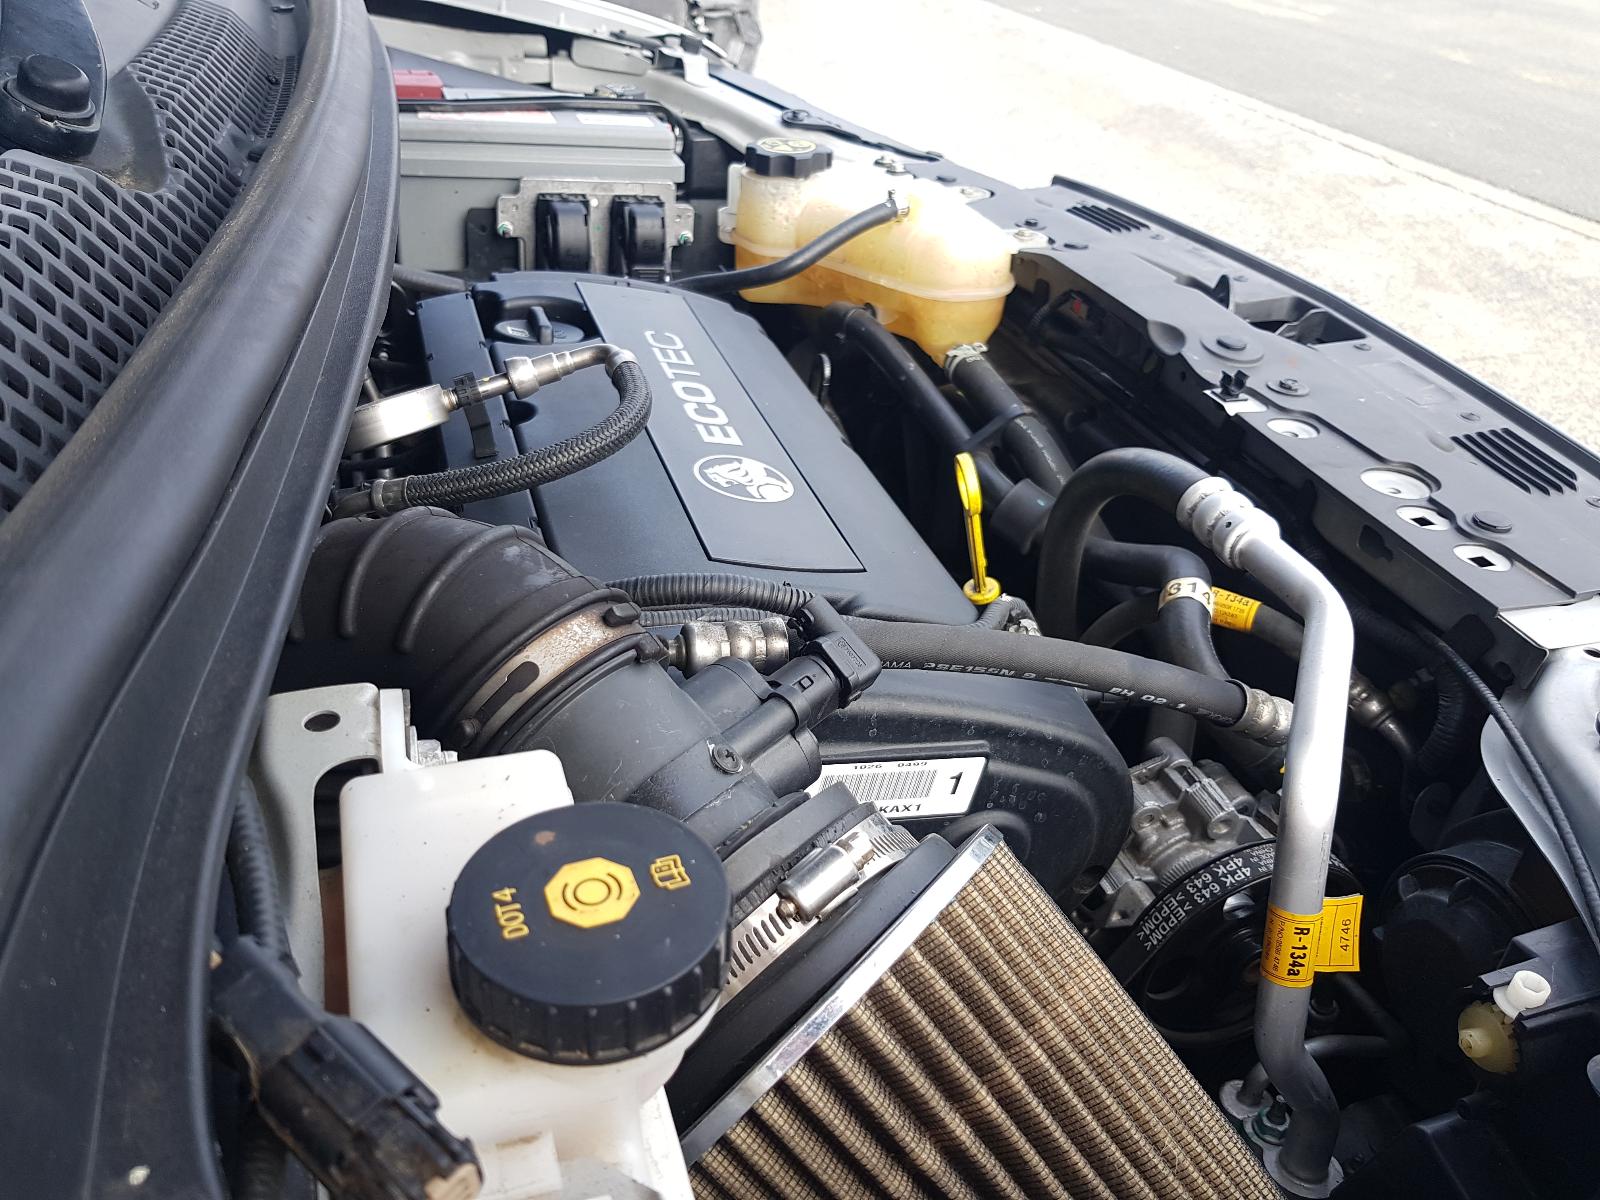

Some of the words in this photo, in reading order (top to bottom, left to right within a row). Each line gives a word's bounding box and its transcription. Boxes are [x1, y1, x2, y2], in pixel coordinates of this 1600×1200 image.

[644, 330, 744, 446] ECOTEC
[949, 771, 964, 795] 1
[1211, 856, 1243, 877] 4PK
[1220, 866, 1251, 887] 4PK
[491, 886, 518, 902] 4
[1186, 872, 1212, 894] 643
[1193, 882, 1221, 904] 643
[494, 903, 530, 939] DOT
[1340, 918, 1353, 952] 4746
[1287, 926, 1311, 977] R-134a
